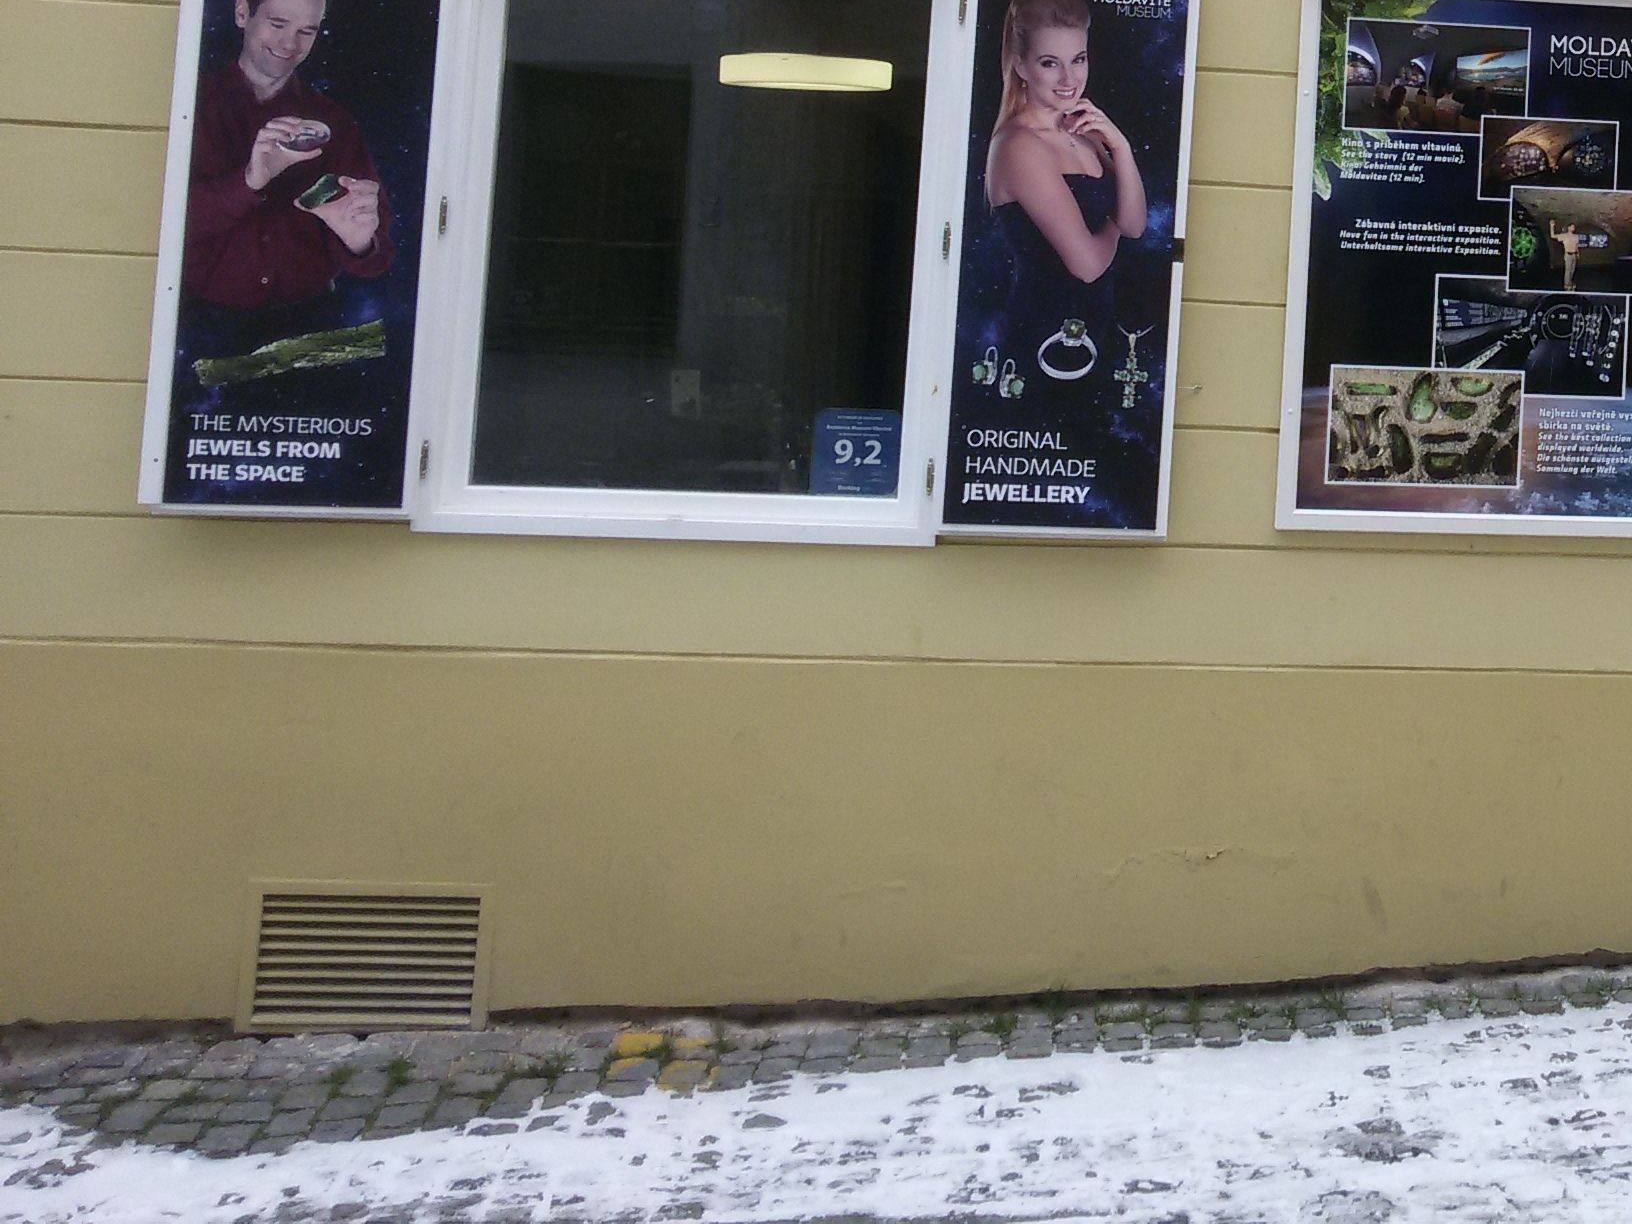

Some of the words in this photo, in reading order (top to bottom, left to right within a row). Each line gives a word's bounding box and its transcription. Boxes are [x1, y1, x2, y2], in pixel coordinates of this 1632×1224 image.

[1116, 4, 1171, 19] MUSEUM
[1366, 140, 1371, 148] s
[1374, 151, 1398, 162] story
[1408, 163, 1423, 172] der
[1339, 229, 1361, 239] Have
[1363, 230, 1378, 240] fun
[1380, 231, 1388, 240] in
[1391, 231, 1404, 241] the
[1406, 232, 1453, 243] interactive
[190, 413, 231, 432] THE
[236, 415, 372, 435] MYSTERIOUS
[1570, 422, 1582, 431] na
[966, 428, 1068, 451] ORIGINAL
[1537, 431, 1553, 441] See
[1555, 432, 1569, 441] the
[1591, 433, 1632, 443] collection
[186, 439, 271, 458] JEWELS
[276, 440, 341, 459] FROM
[834, 438, 882, 466] 9,2
[1537, 442, 1578, 453] displayed
[1536, 453, 1550, 462] Die
[186, 463, 230, 481] THE
[235, 464, 305, 482] SPACE
[965, 456, 1096, 478] HANDMADE
[1580, 464, 1595, 474] der
[962, 482, 1090, 504] JEWELLERY
